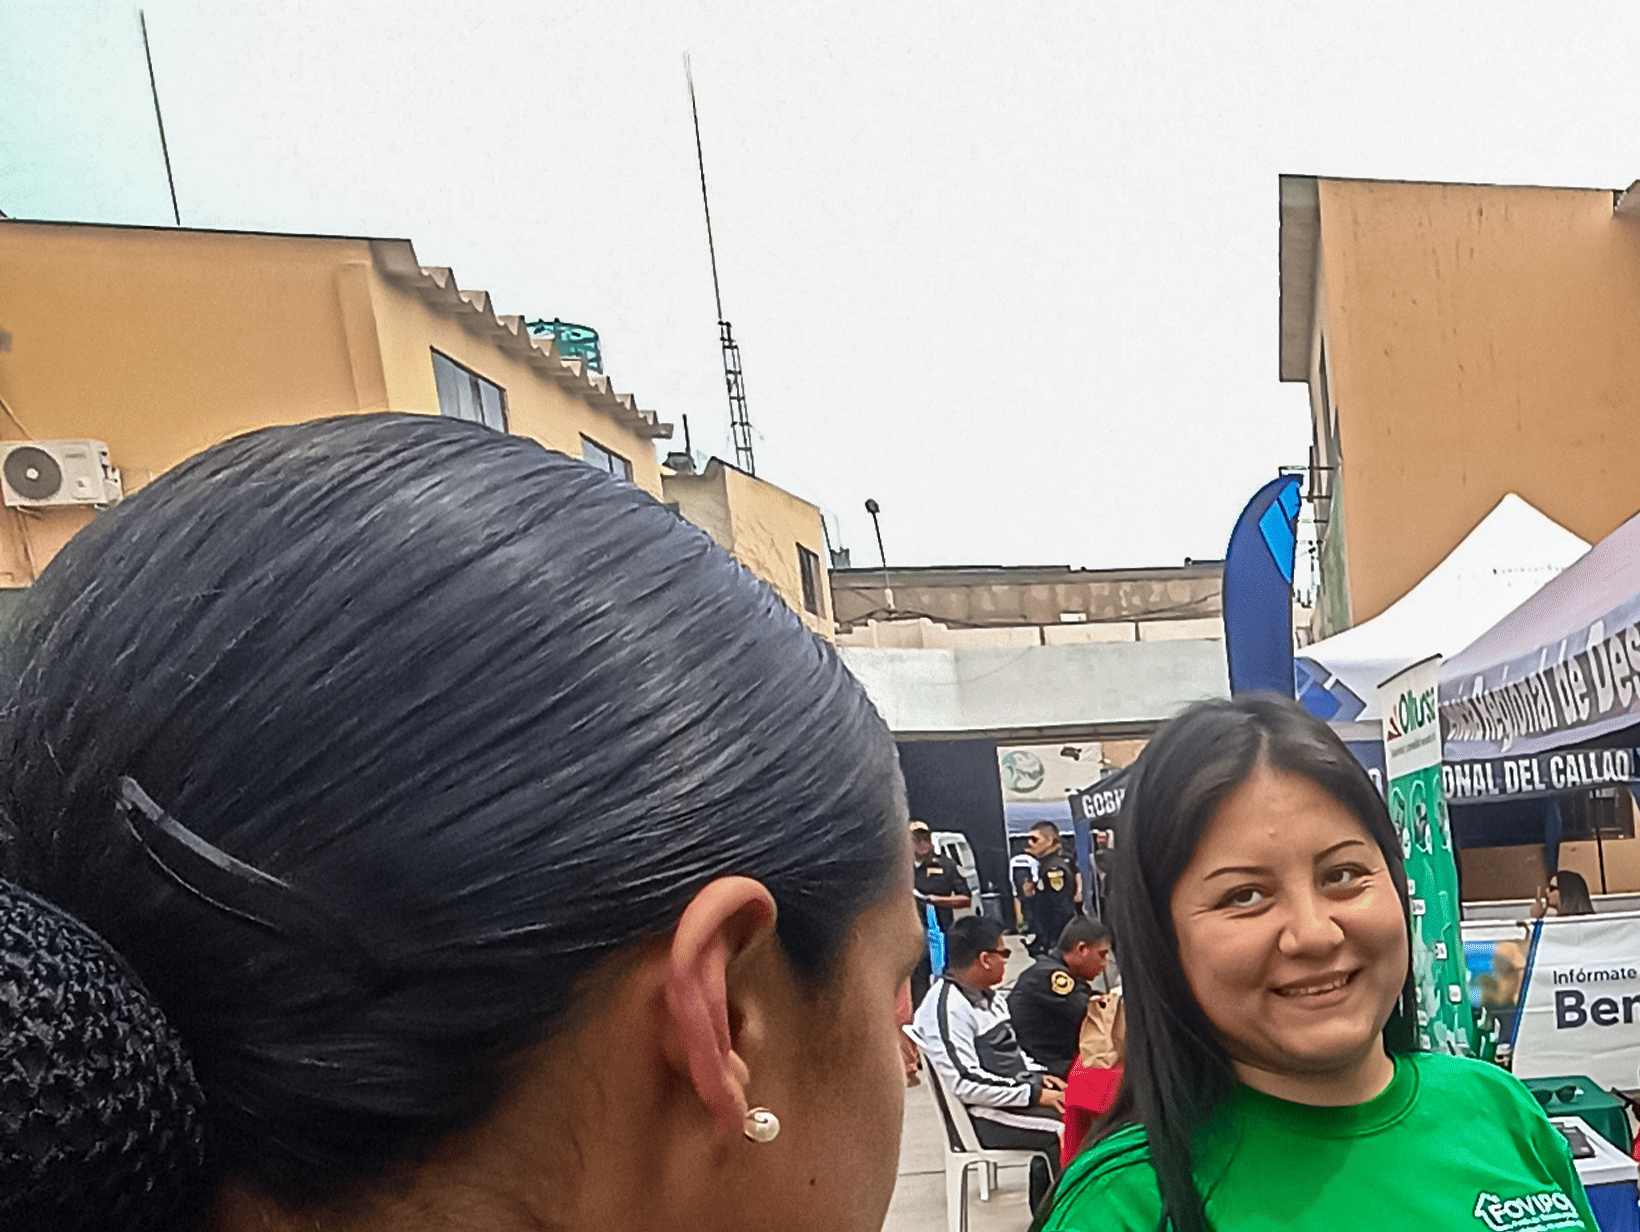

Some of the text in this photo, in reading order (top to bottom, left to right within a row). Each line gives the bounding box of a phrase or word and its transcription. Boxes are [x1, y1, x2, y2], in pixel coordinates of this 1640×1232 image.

[1504, 758, 1546, 794] DEL
[1550, 750, 1631, 789] CALLAO
[1553, 967, 1638, 985] Infórmate
